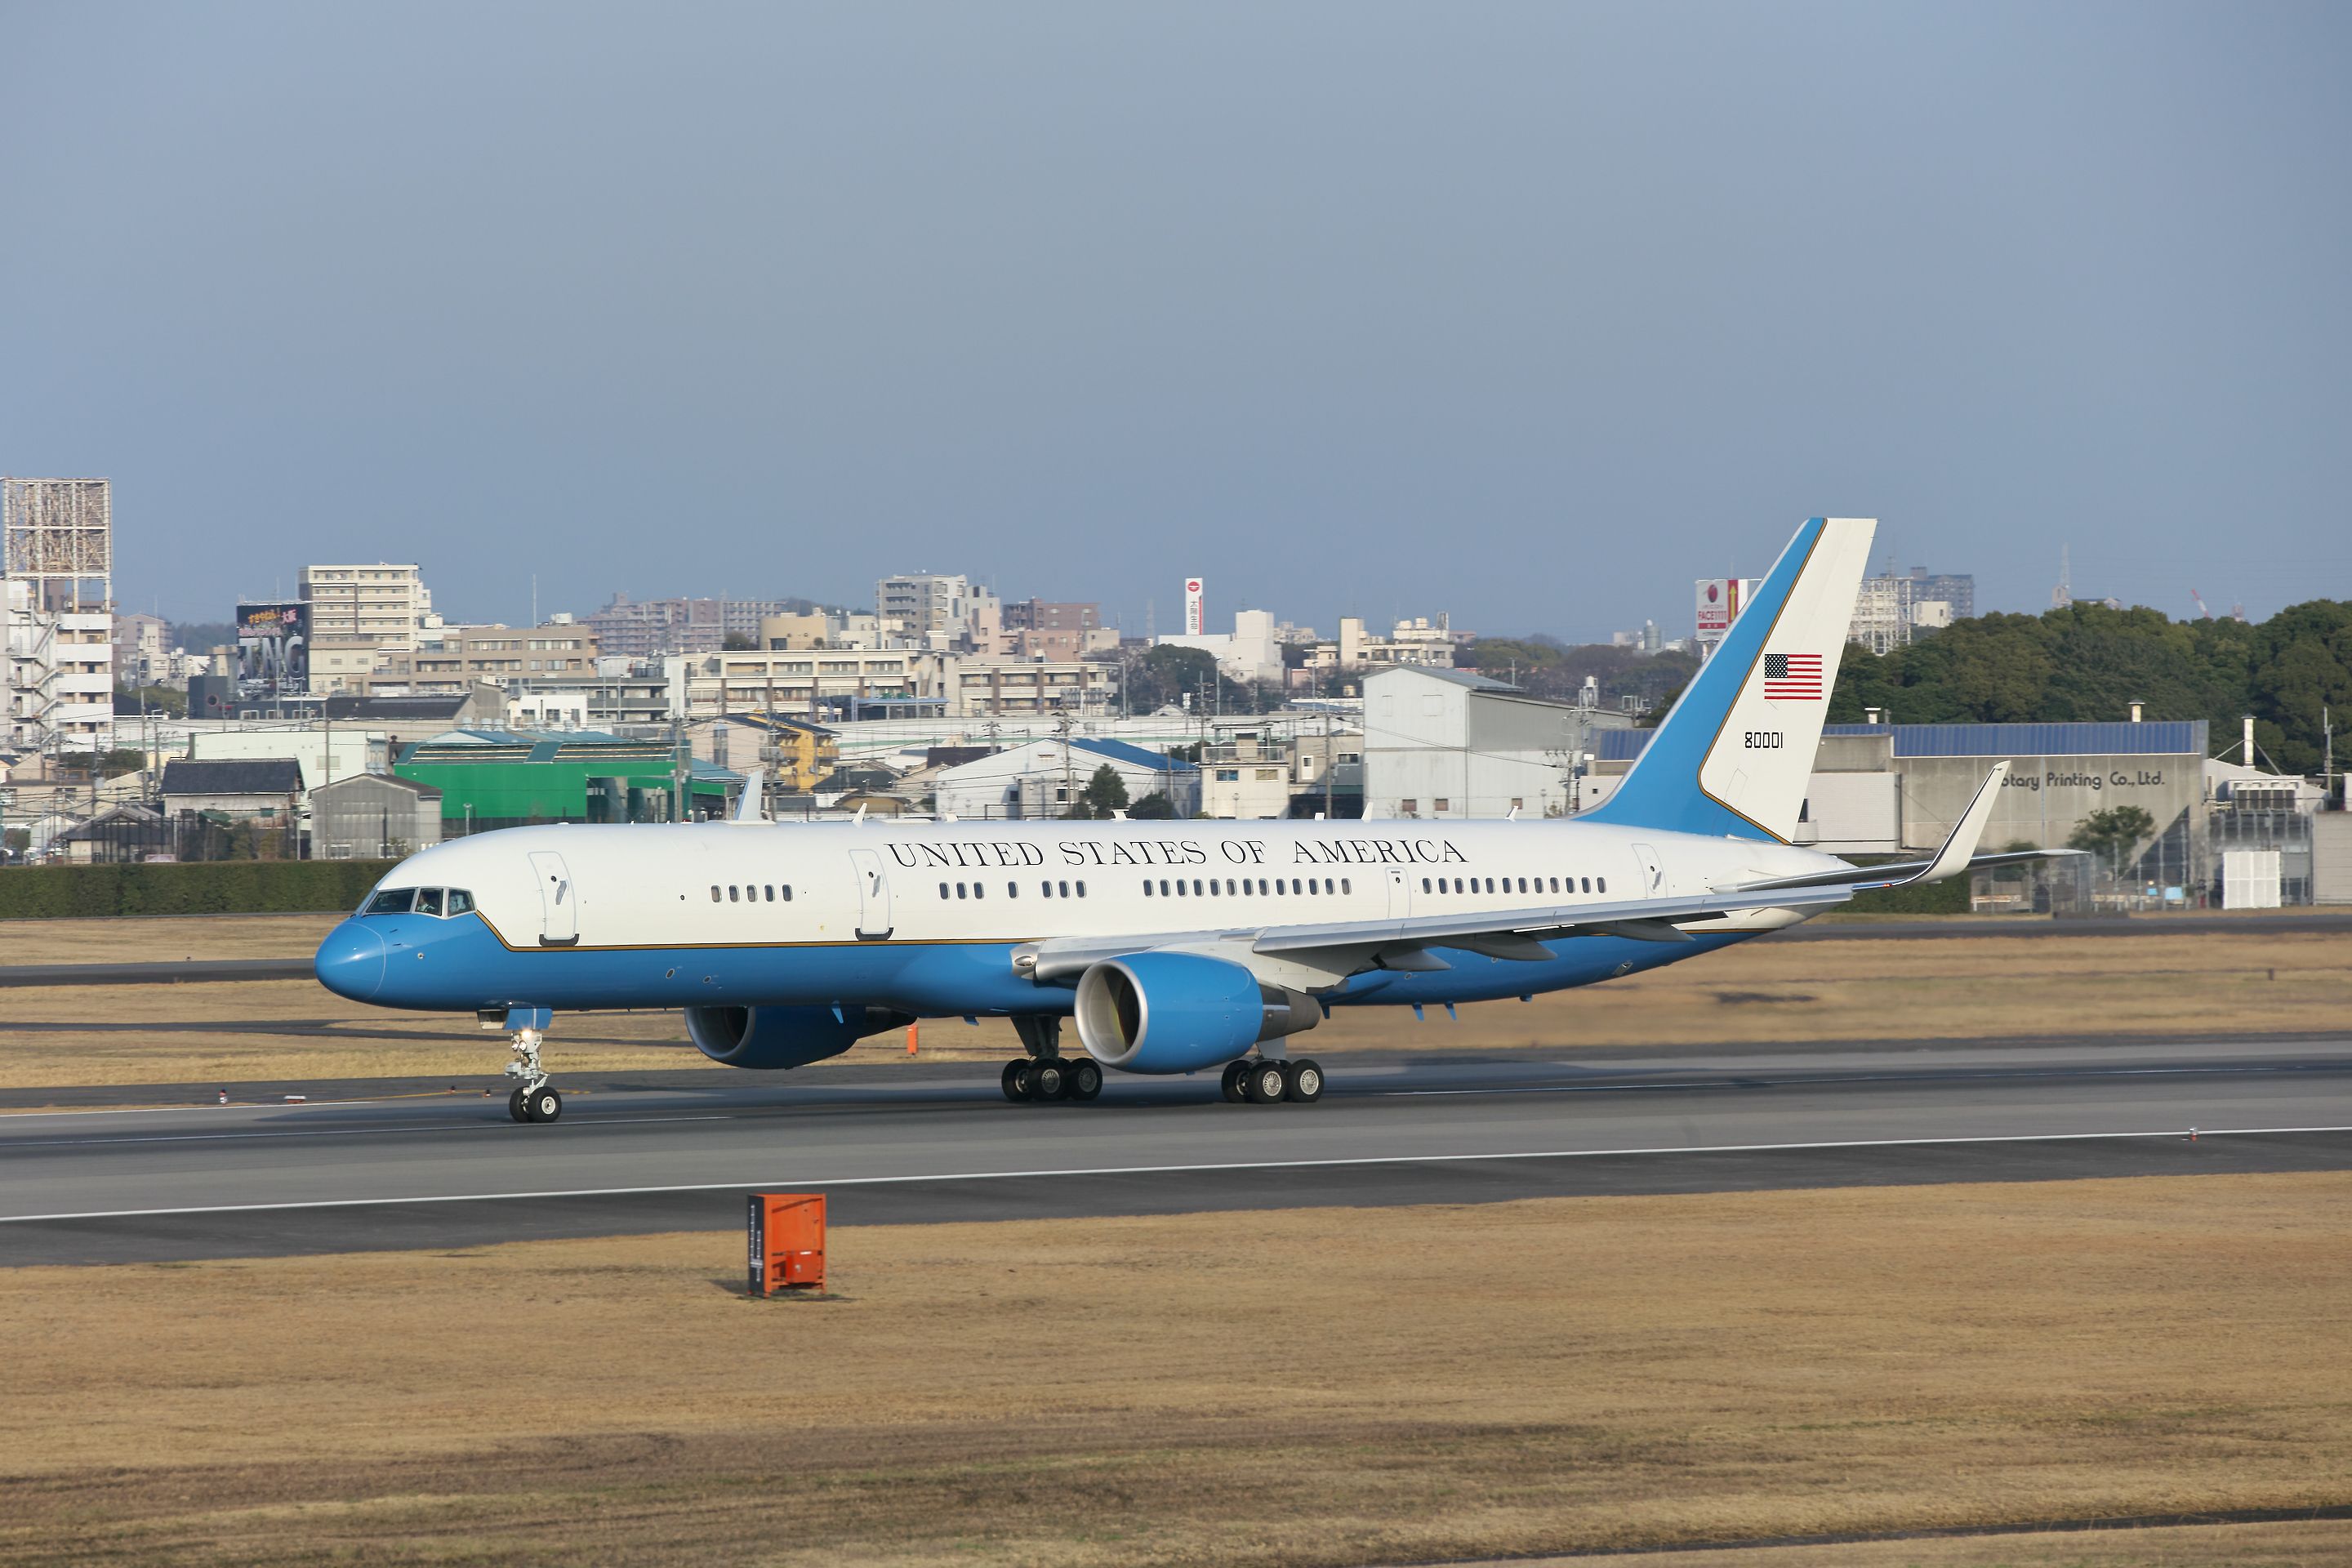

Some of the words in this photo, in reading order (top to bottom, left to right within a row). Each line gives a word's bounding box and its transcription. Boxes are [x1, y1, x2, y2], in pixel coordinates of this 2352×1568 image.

[1744, 731, 1784, 749] 80001
[2046, 772, 2102, 791] Printing
[884, 842, 1045, 867] UNITED
[1058, 840, 1207, 866] STATES
[1220, 840, 1267, 865] OF
[1292, 839, 1469, 864] AMERICA
